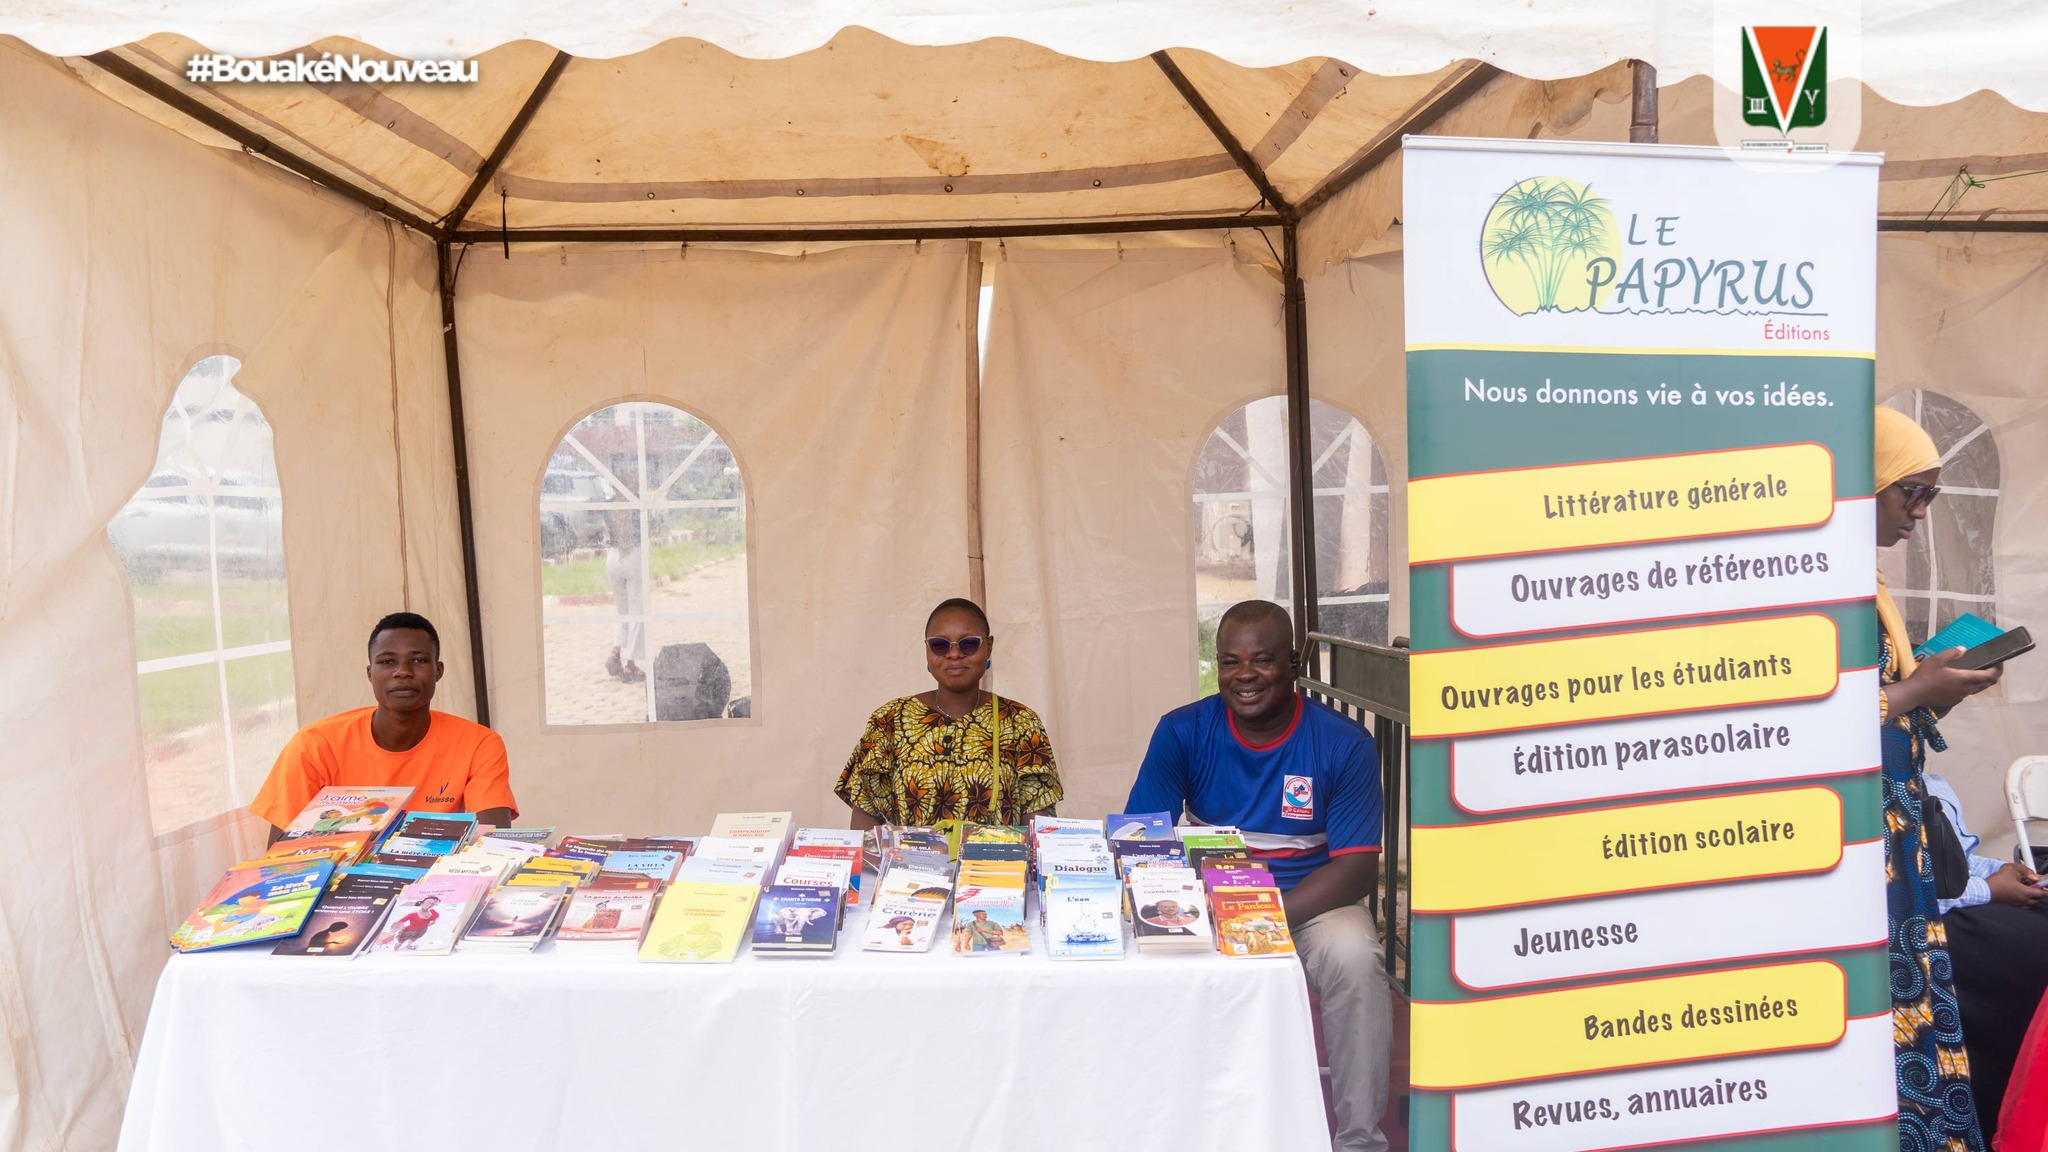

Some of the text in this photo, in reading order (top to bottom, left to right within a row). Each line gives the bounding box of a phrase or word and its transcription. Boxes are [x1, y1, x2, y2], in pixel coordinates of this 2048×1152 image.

[1627, 213, 1680, 246] LE
[1585, 256, 1815, 310] PAPYRUS
[1763, 320, 1830, 341] Éditions
[1464, 378, 1834, 408] Nous donnons vie à vos idées.
[1544, 474, 1788, 519] Littérature générale
[1511, 550, 1829, 602] Ouvrages de références
[1441, 652, 1793, 711] Ouvrages pour les étudiants
[1512, 722, 1791, 776] Édition parascolaire
[1601, 817, 1796, 860] Édition scolaire
[783, 877, 834, 887] Courses
[1054, 865, 1108, 873] Dialogue
[1221, 902, 1276, 911] Le Fardeau
[1513, 921, 1639, 958] Jeunesse
[1584, 994, 1799, 1042] Bandes dessinées
[1512, 1076, 1769, 1131] Revues, annuaires
